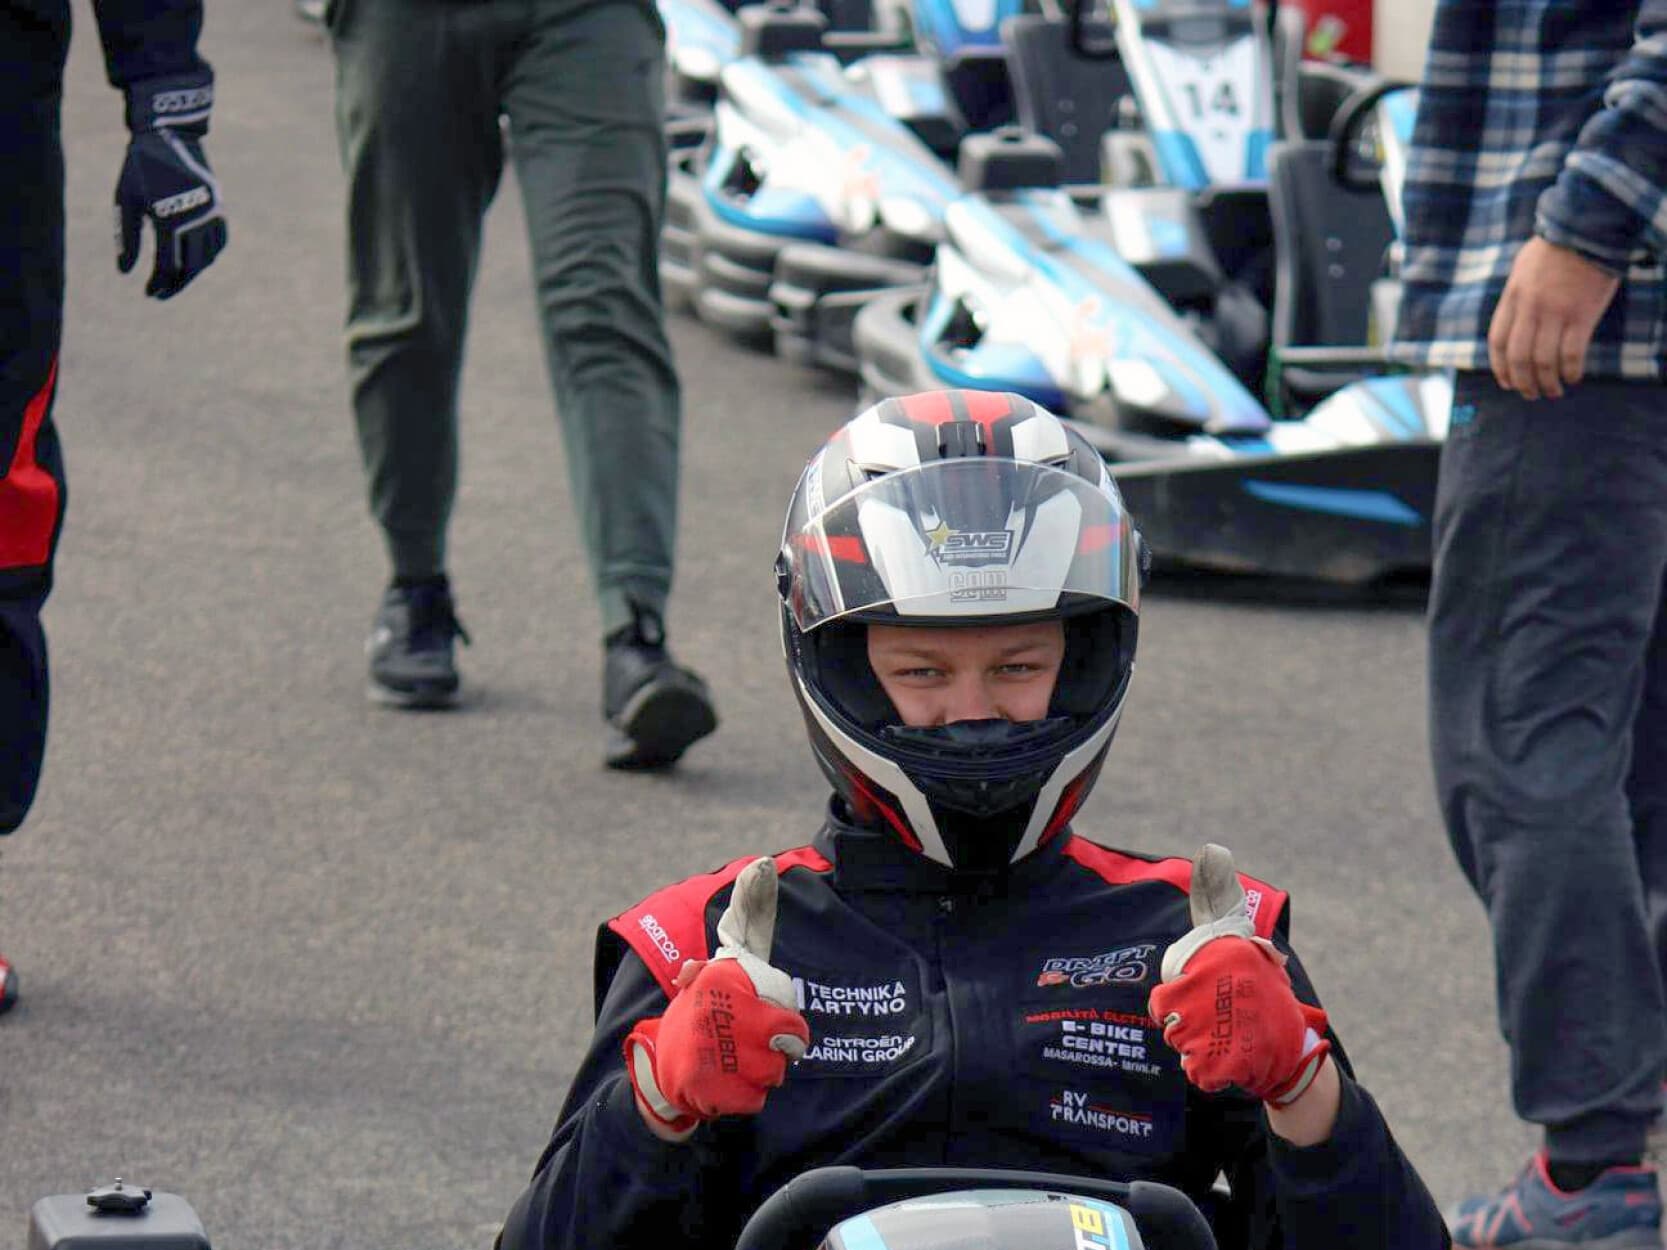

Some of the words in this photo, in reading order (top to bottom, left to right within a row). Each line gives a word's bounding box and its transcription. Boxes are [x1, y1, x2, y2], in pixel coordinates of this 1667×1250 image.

[1183, 82, 1239, 117] 14
[638, 914, 681, 963] sparco
[807, 981, 906, 1001] TECHNIKA
[809, 998, 905, 1015] ARTYNO
[1062, 1035, 1146, 1060] CENTER
[1063, 1090, 1088, 1107] RV
[1050, 1103, 1153, 1137] TRANSPORT
